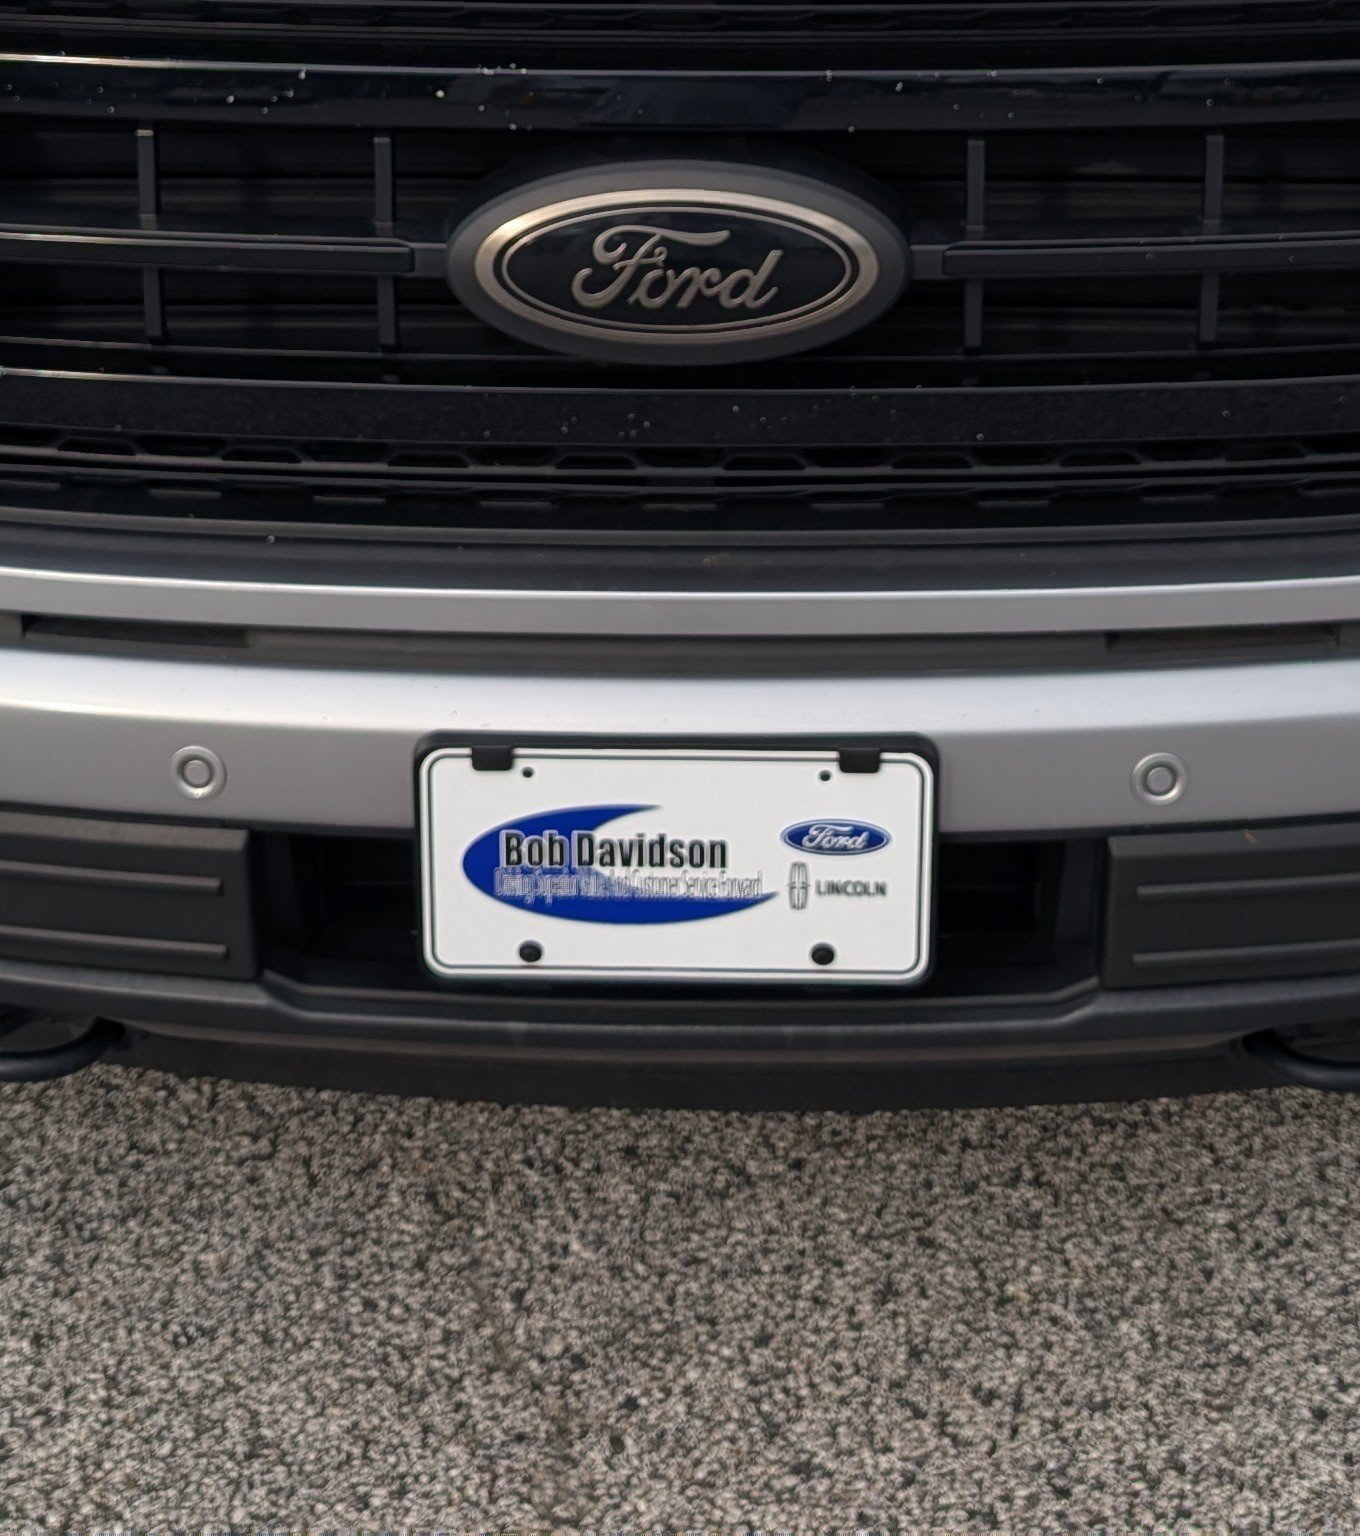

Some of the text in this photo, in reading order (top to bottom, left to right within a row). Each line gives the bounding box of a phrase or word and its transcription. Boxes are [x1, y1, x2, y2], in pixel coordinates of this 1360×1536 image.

[571, 224, 783, 310] Ford
[503, 831, 729, 868] Bob Davidson
[801, 823, 870, 849] Ford
[815, 880, 887, 897] LINCOLN
